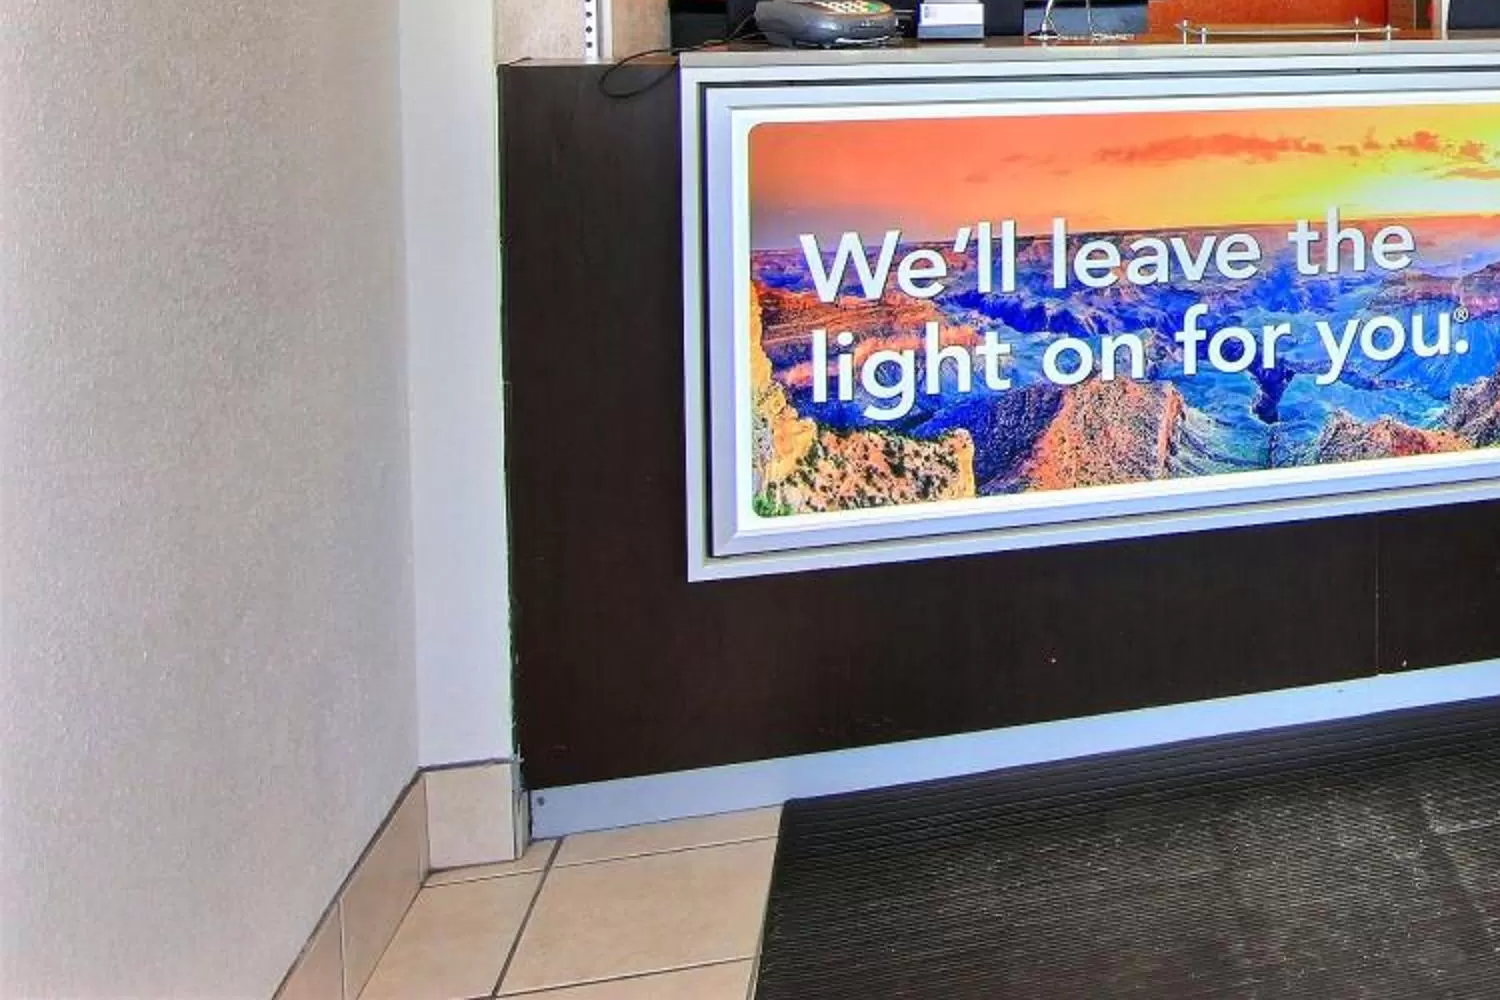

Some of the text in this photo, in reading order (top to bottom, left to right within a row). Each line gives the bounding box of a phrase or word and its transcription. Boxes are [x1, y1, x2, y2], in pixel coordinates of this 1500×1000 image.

[800, 207, 1416, 303] We'll leave the
[812, 321, 1013, 421] light
[1042, 331, 1146, 386] on
[1175, 303, 1292, 376] for
